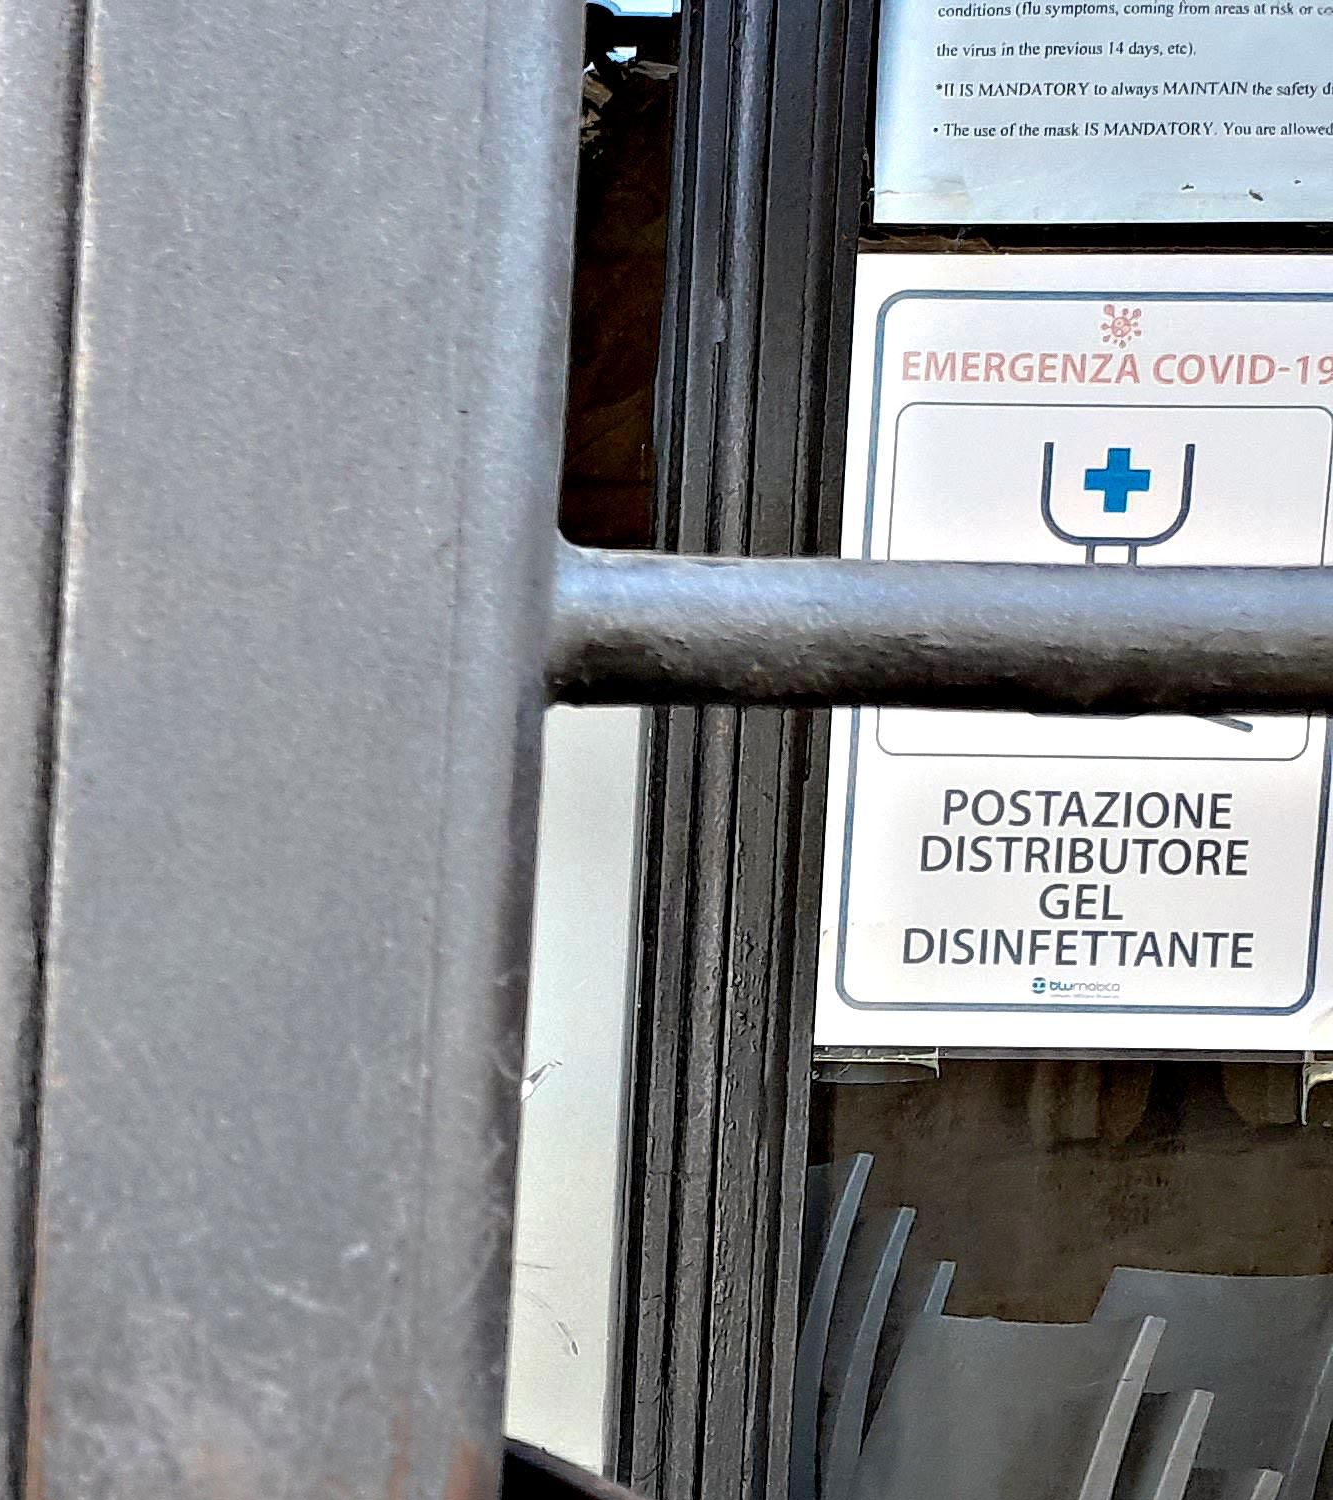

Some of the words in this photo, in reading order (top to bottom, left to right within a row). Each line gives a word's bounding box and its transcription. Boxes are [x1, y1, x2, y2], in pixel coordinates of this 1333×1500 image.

[938, 3, 1011, 18] conditions
[1124, 0, 1174, 18] coming
[1179, 0, 1209, 15] from
[937, 44, 957, 57] the
[963, 44, 996, 57] virus
[1002, 43, 1014, 57] in
[1019, 42, 1040, 56] the
[1045, 42, 1102, 59] previous
[1110, 42, 1123, 55] 14
[1129, 42, 1163, 58] days,
[960, 84, 973, 97] IS
[979, 81, 1089, 97] MANDATORY
[1095, 84, 1107, 95] to
[1111, 81, 1158, 98] always
[1164, 81, 1248, 95] MAINTAIN
[1253, 82, 1272, 96] the
[1277, 82, 1317, 99] safety
[944, 122, 969, 136] The
[974, 127, 996, 136] use
[1000, 122, 1017, 137] of
[1018, 122, 1040, 137] the
[1044, 123, 1078, 137] mask
[1085, 123, 1099, 137] IS
[1224, 122, 1251, 136] You
[1256, 125, 1275, 135] are
[1281, 122, 1333, 135] allowed
[903, 352, 1140, 384] EMERGENZA
[1153, 353, 1333, 385] COVID-19
[944, 789, 1232, 830] POSTAZIONE
[921, 835, 1248, 876] DISTRIBUTORE
[1040, 883, 1123, 921] GEL
[903, 928, 1253, 969] DISINFETTANTE
